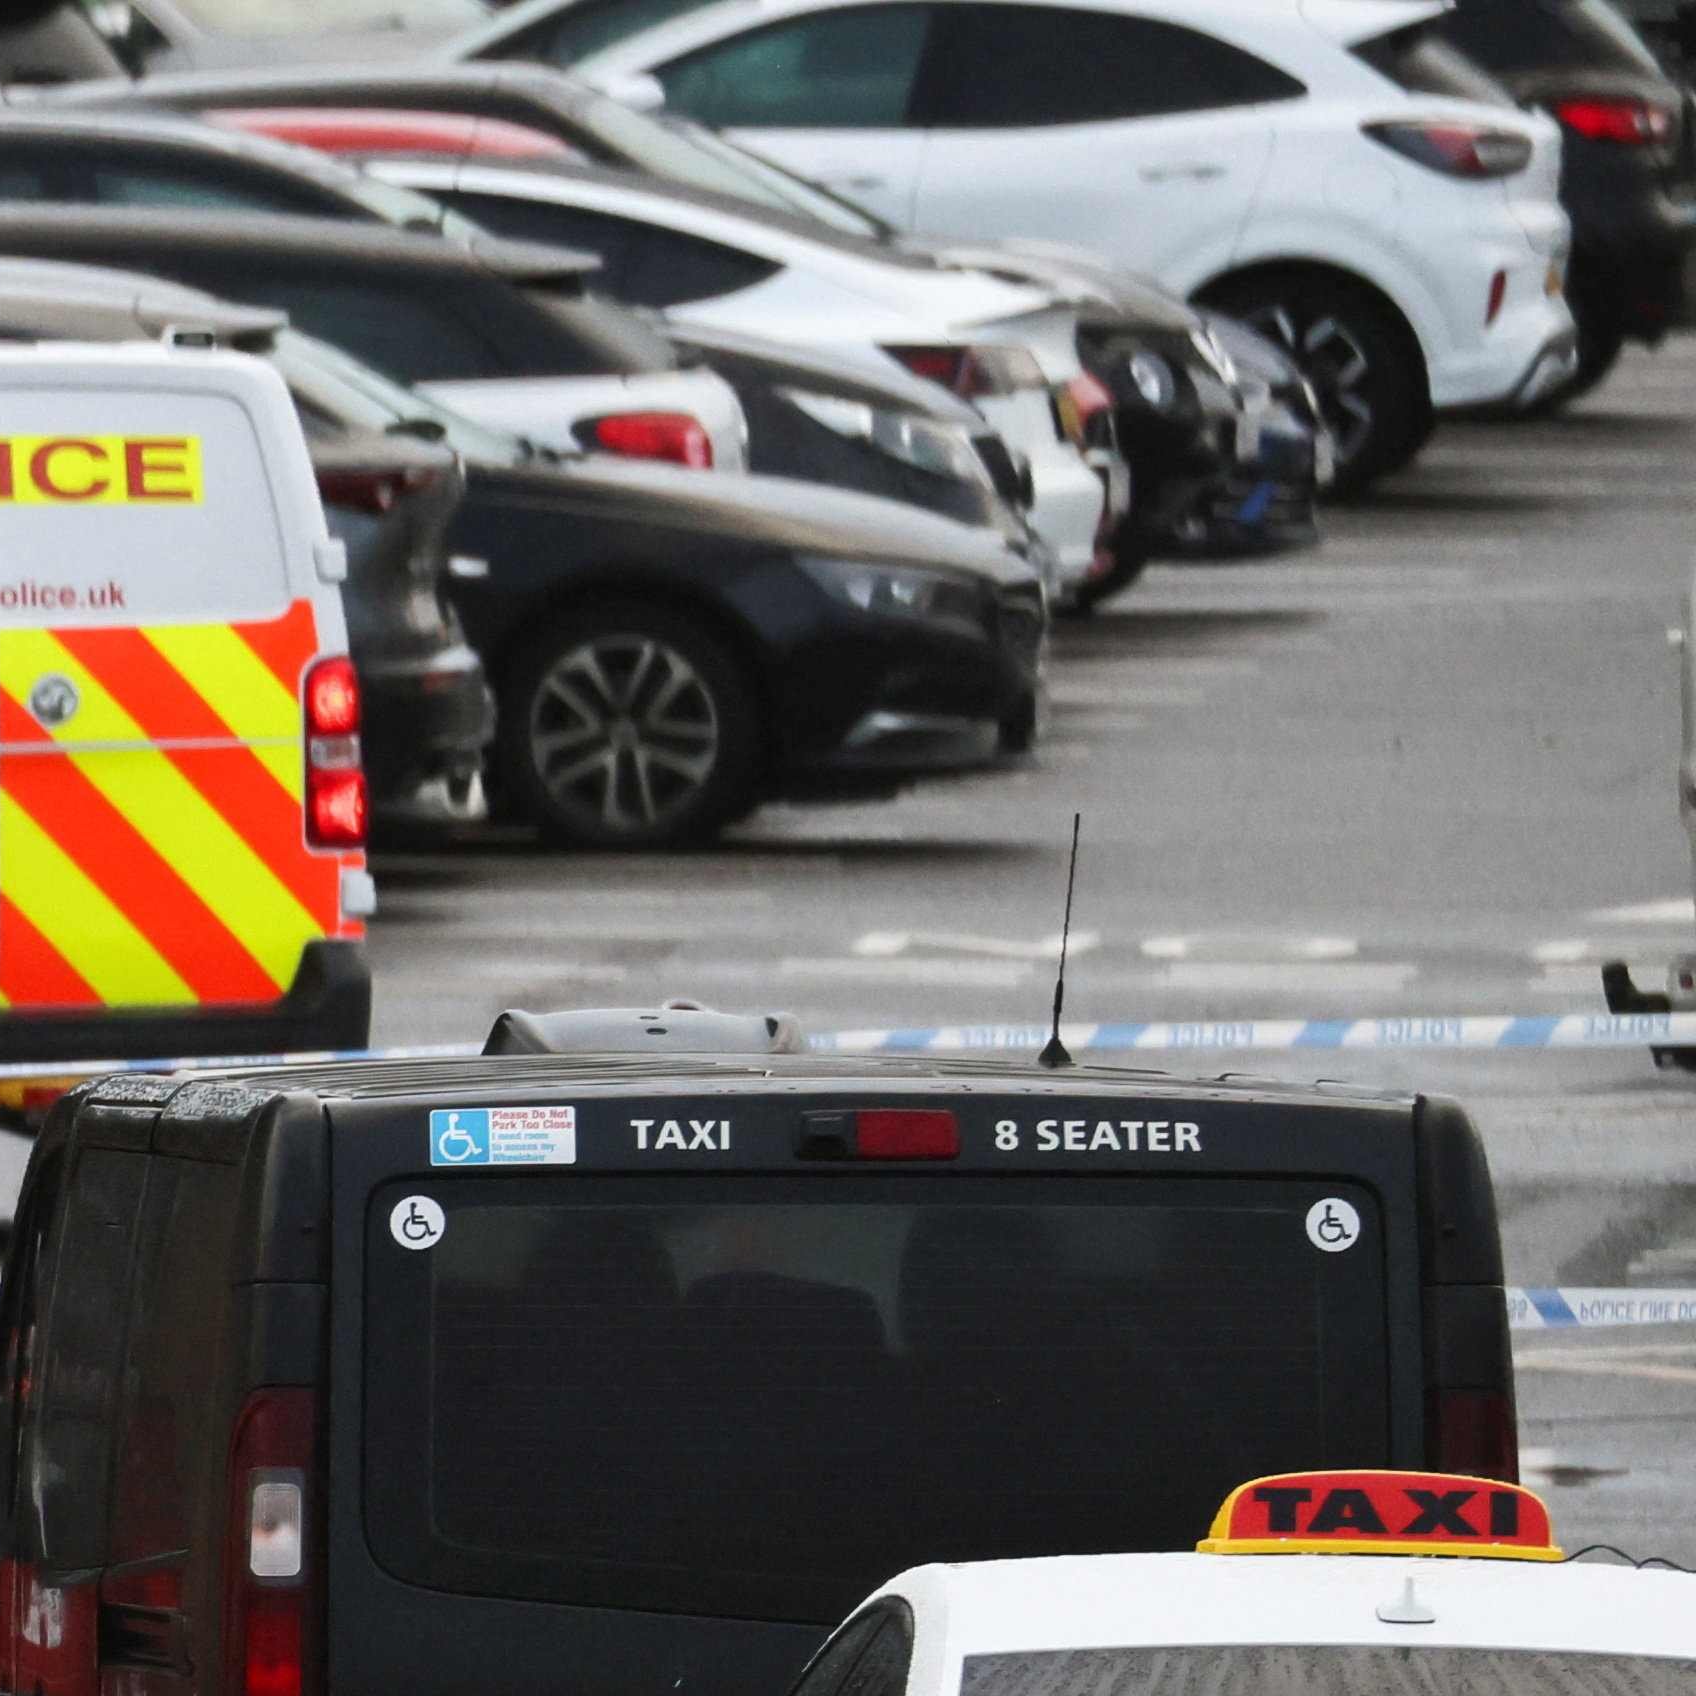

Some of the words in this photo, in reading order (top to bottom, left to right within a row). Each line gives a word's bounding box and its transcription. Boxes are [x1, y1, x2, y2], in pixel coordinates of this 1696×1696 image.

[491, 1109, 529, 1120] Please
[531, 1109, 547, 1120] Do
[549, 1108, 569, 1119] Not
[491, 1120, 517, 1130] Park
[520, 1119, 540, 1130] Too
[542, 1119, 573, 1129] Close
[629, 1119, 730, 1150] TAXI
[995, 1120, 1019, 1151] 8
[1036, 1119, 1202, 1152] SEATER
[1253, 1487, 1519, 1538] TAXI
